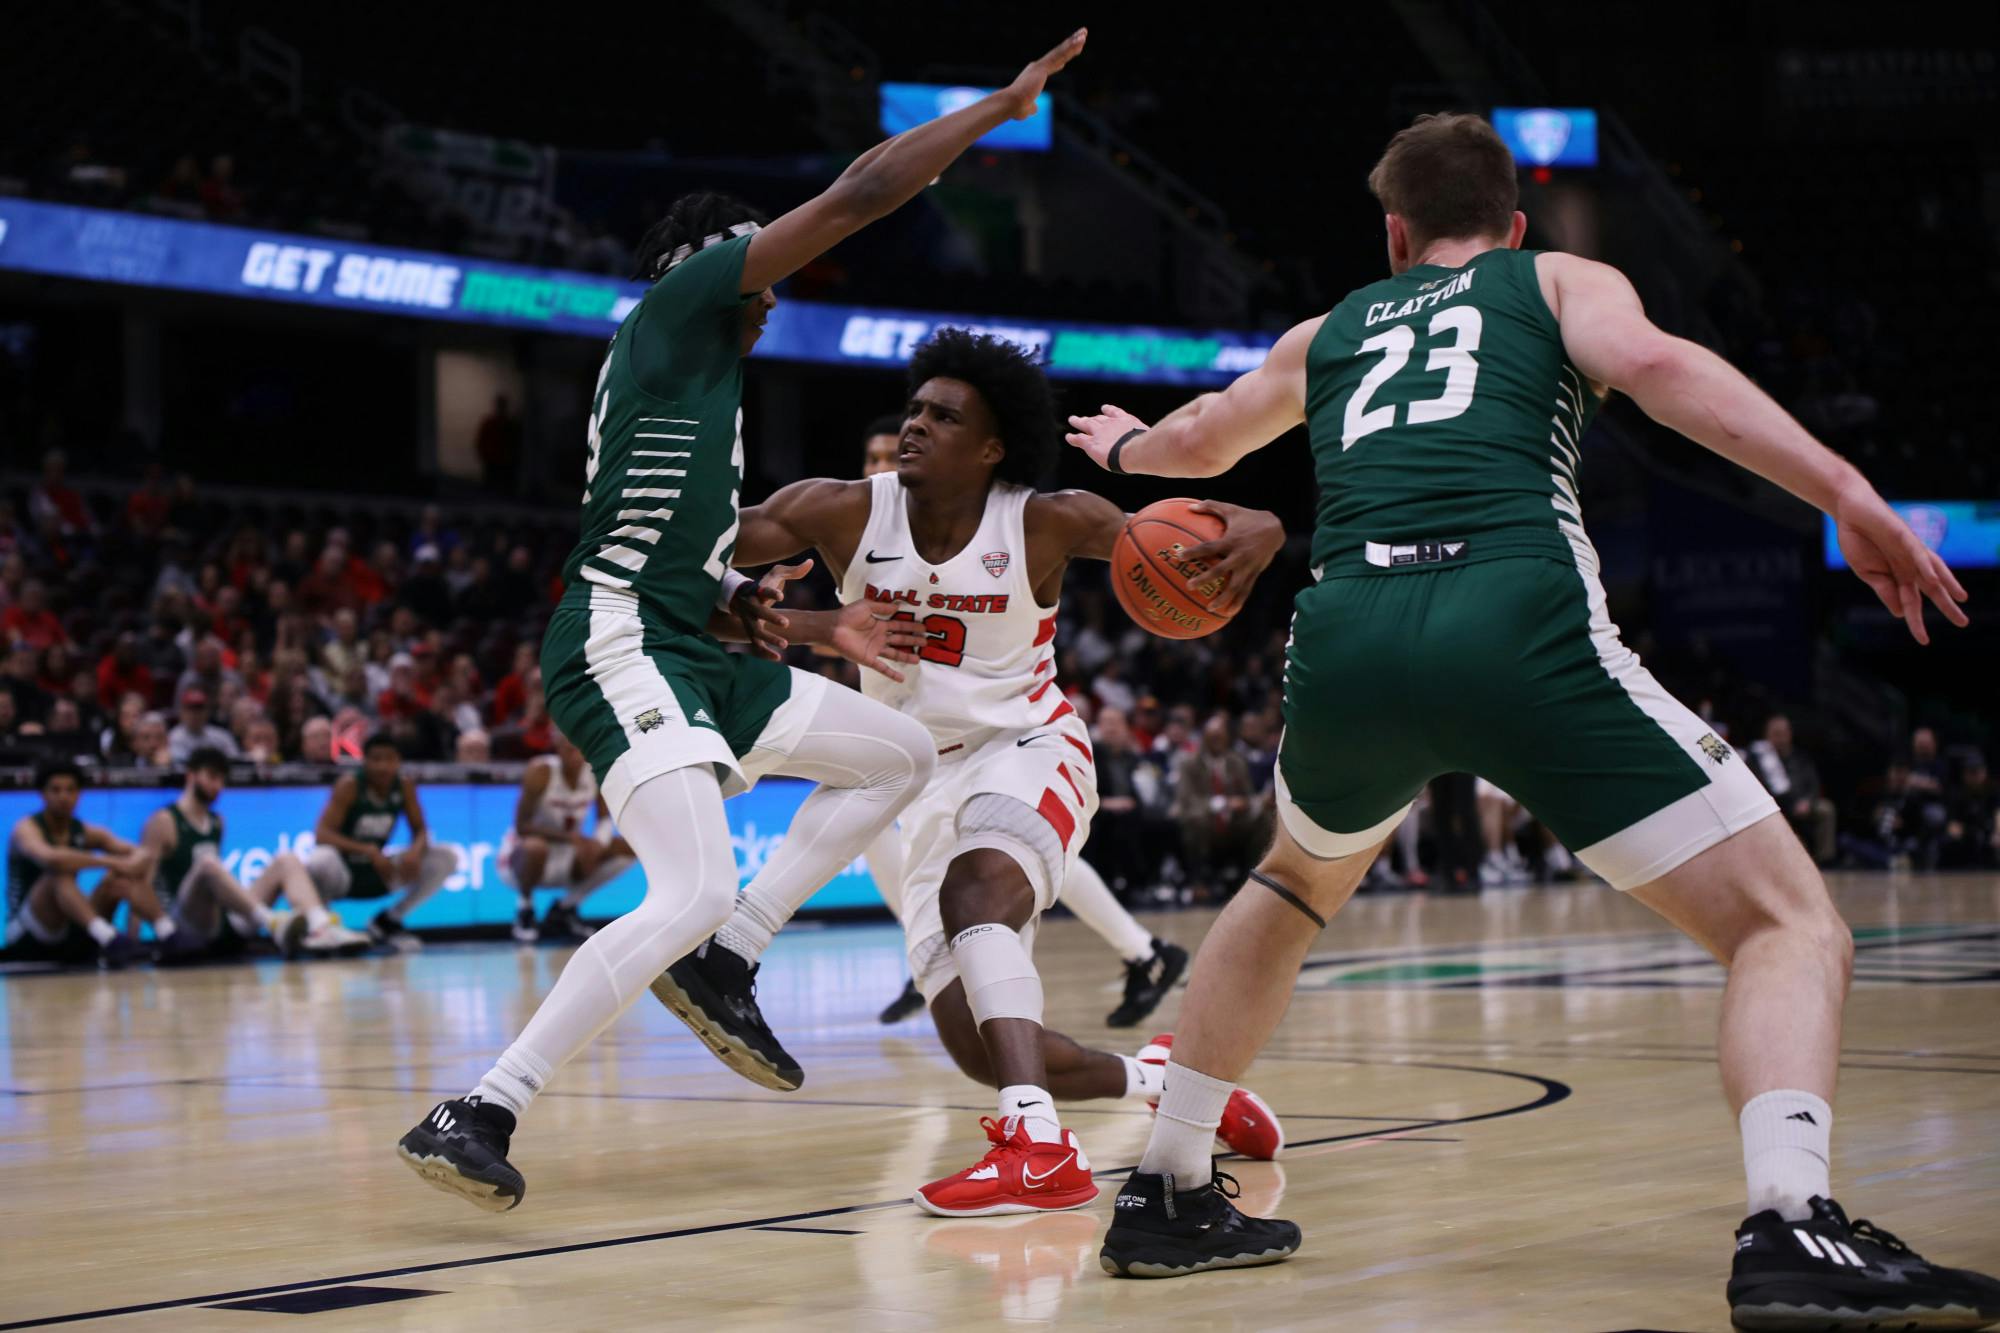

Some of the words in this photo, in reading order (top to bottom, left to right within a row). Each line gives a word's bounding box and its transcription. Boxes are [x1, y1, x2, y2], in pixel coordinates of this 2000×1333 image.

[242, 241, 333, 293] GET
[334, 254, 461, 308] SOME
[1365, 268, 1477, 327] CLAYTON
[1341, 305, 1482, 452] 23
[926, 593, 1010, 613] STATE
[1128, 562, 1207, 631] SPALDING
[959, 926, 993, 942] PRO
[1132, 1195, 1147, 1204] ONE
